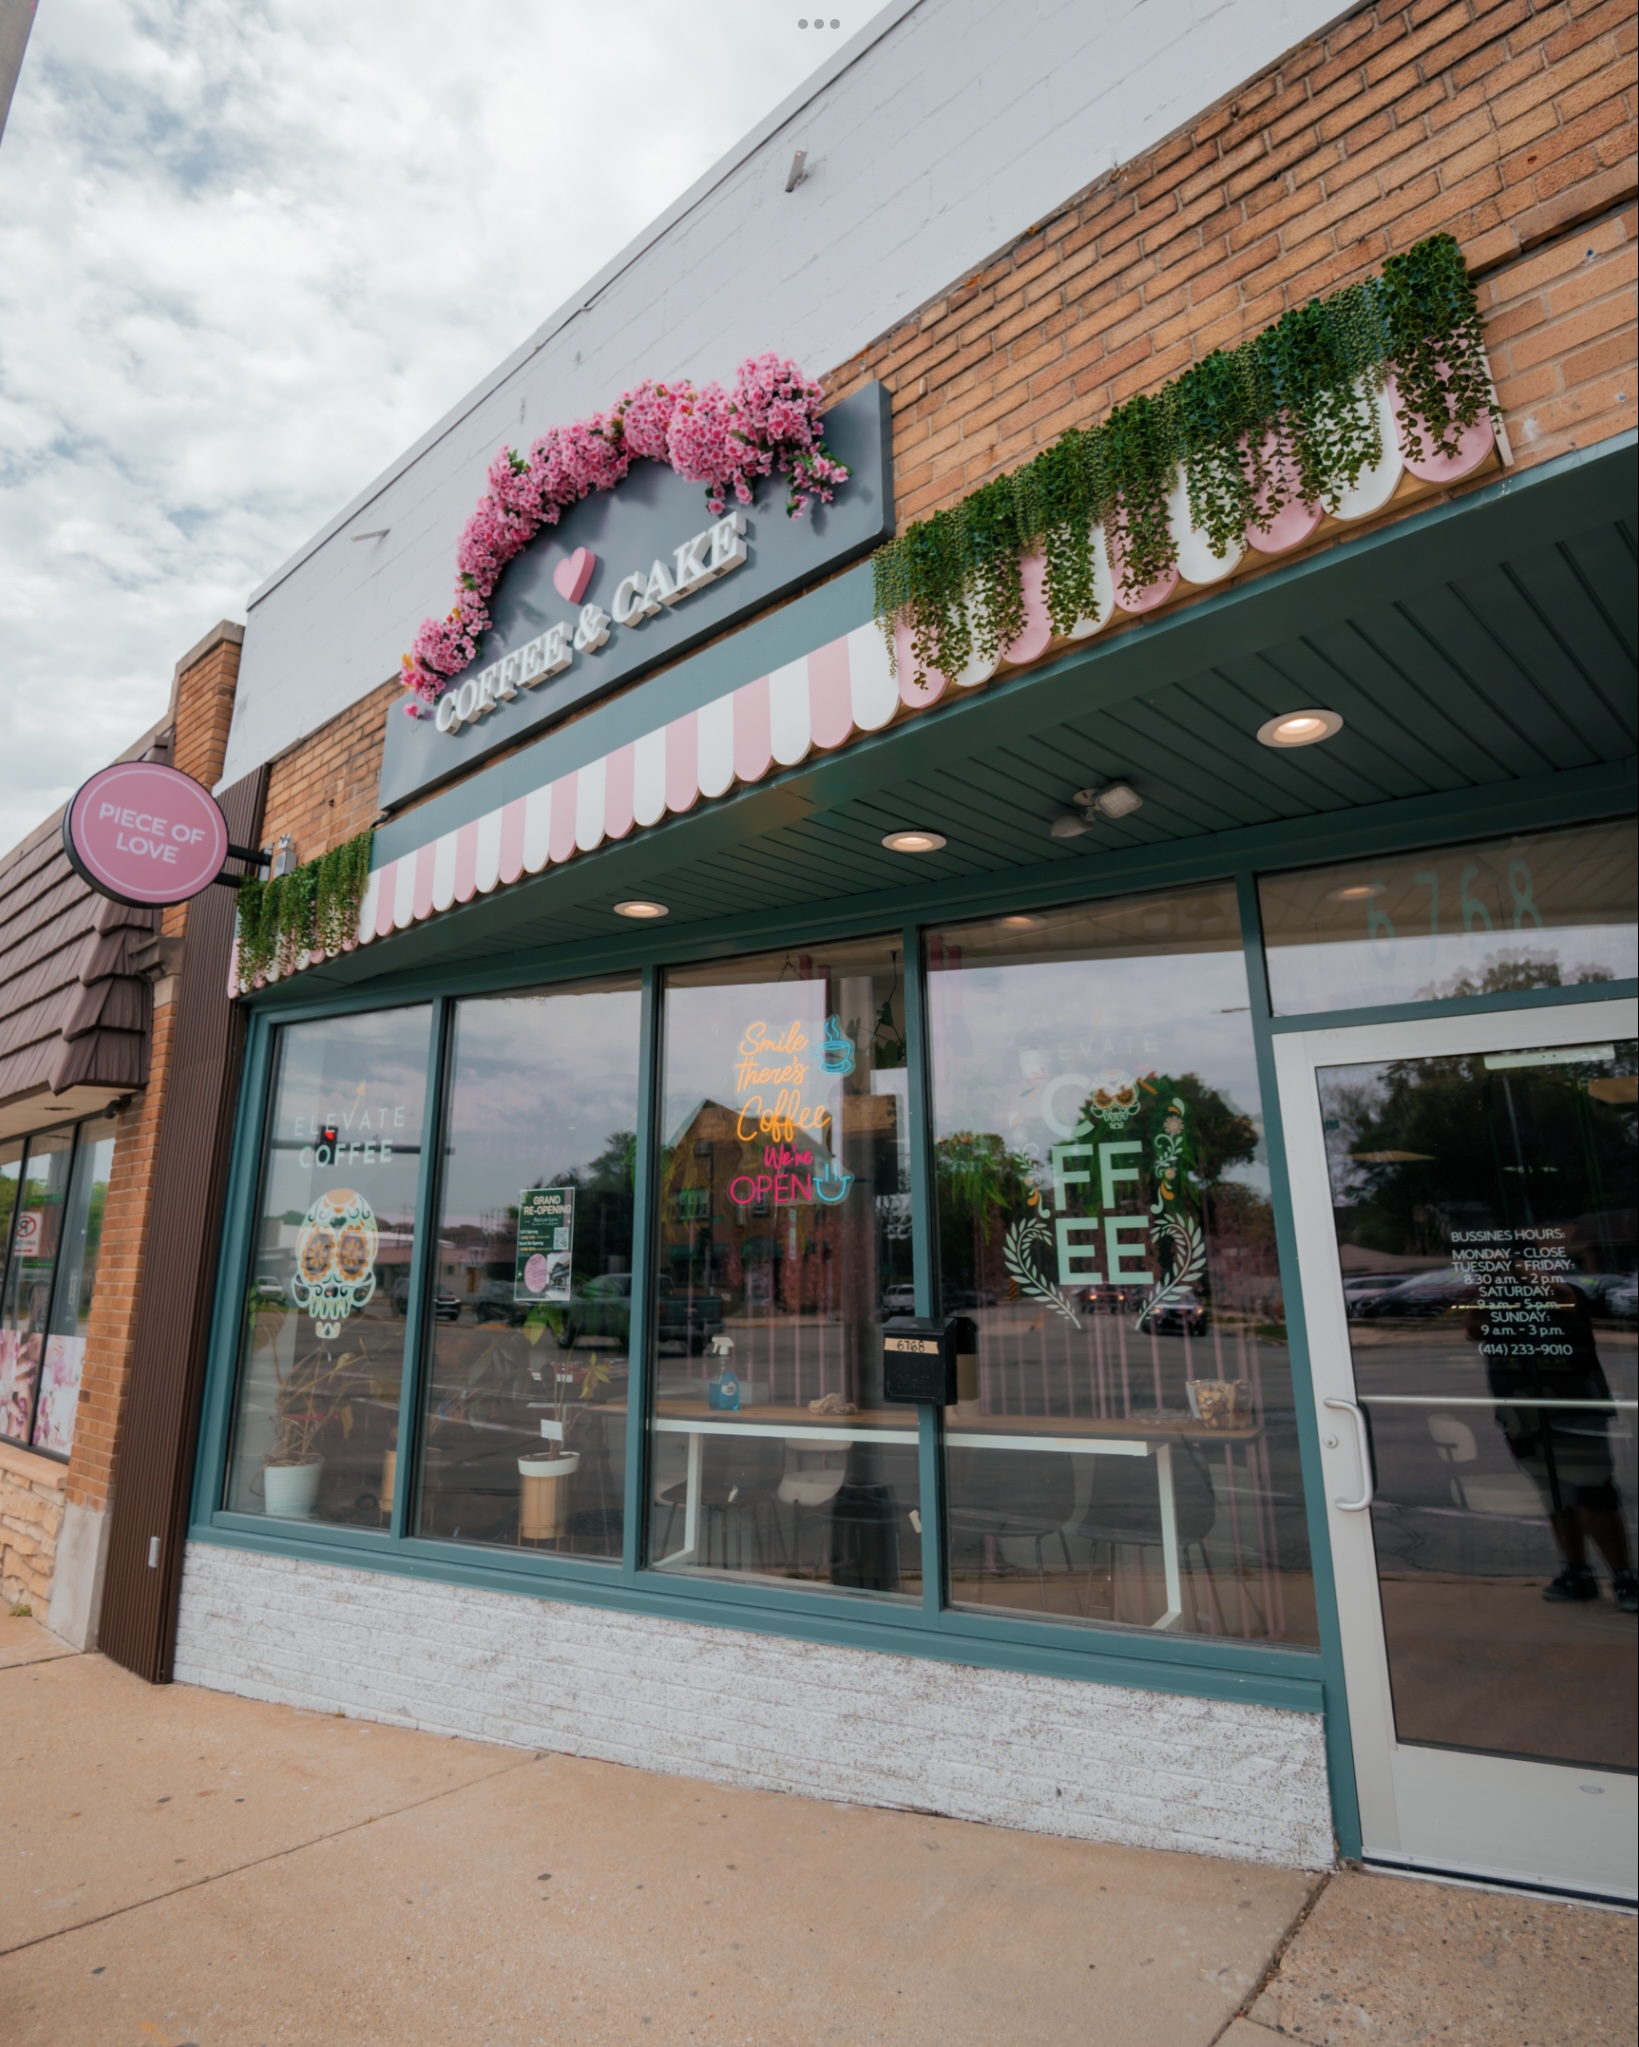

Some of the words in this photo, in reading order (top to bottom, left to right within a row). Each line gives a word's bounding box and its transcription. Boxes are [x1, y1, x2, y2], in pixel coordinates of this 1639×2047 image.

[435, 621, 573, 735] COFFEE
[573, 602, 611, 654] &
[612, 511, 747, 628] CAKE
[99, 802, 167, 837] PIECE
[171, 824, 205, 845] OF
[116, 832, 179, 864] LOVE
[1367, 859, 1544, 968] 6768
[738, 1020, 809, 1057] Smile
[294, 1106, 405, 1137] ELEVATE
[736, 1088, 832, 1143] Coffee
[299, 1139, 393, 1168] COFFEE
[763, 1144, 814, 1170] We're
[729, 1173, 812, 1205] OPEN
[533, 1195, 561, 1205] GRAND
[523, 1204, 572, 1215] RE-OPENING
[1451, 1230, 1513, 1242] BUSSINES
[1514, 1228, 1565, 1240] HOURS:
[1452, 1248, 1511, 1260] MONDAY
[1523, 1247, 1567, 1258] CLOSE
[1452, 1260, 1512, 1272] TUESDAY
[1524, 1259, 1575, 1271] FRIDAY:
[1464, 1274, 1492, 1285] 8:30
[1494, 1275, 1518, 1284] a.m.
[1530, 1273, 1539, 1284] 2
[1541, 1274, 1566, 1286] p.m.
[1479, 1285, 1555, 1297] SATURDAY:
[1477, 1299, 1485, 1309] 9
[1523, 1299, 1532, 1309] 5
[1491, 1311, 1551, 1322] SUNDAY:
[1481, 1324, 1489, 1335] 9
[1492, 1326, 1516, 1335] a.m.
[1528, 1325, 1537, 1335] 3
[1540, 1326, 1565, 1337] p.m.
[897, 1340, 925, 1353] 6768
[1478, 1343, 1508, 1356] (414)
[1510, 1344, 1573, 1355] 233-9010
